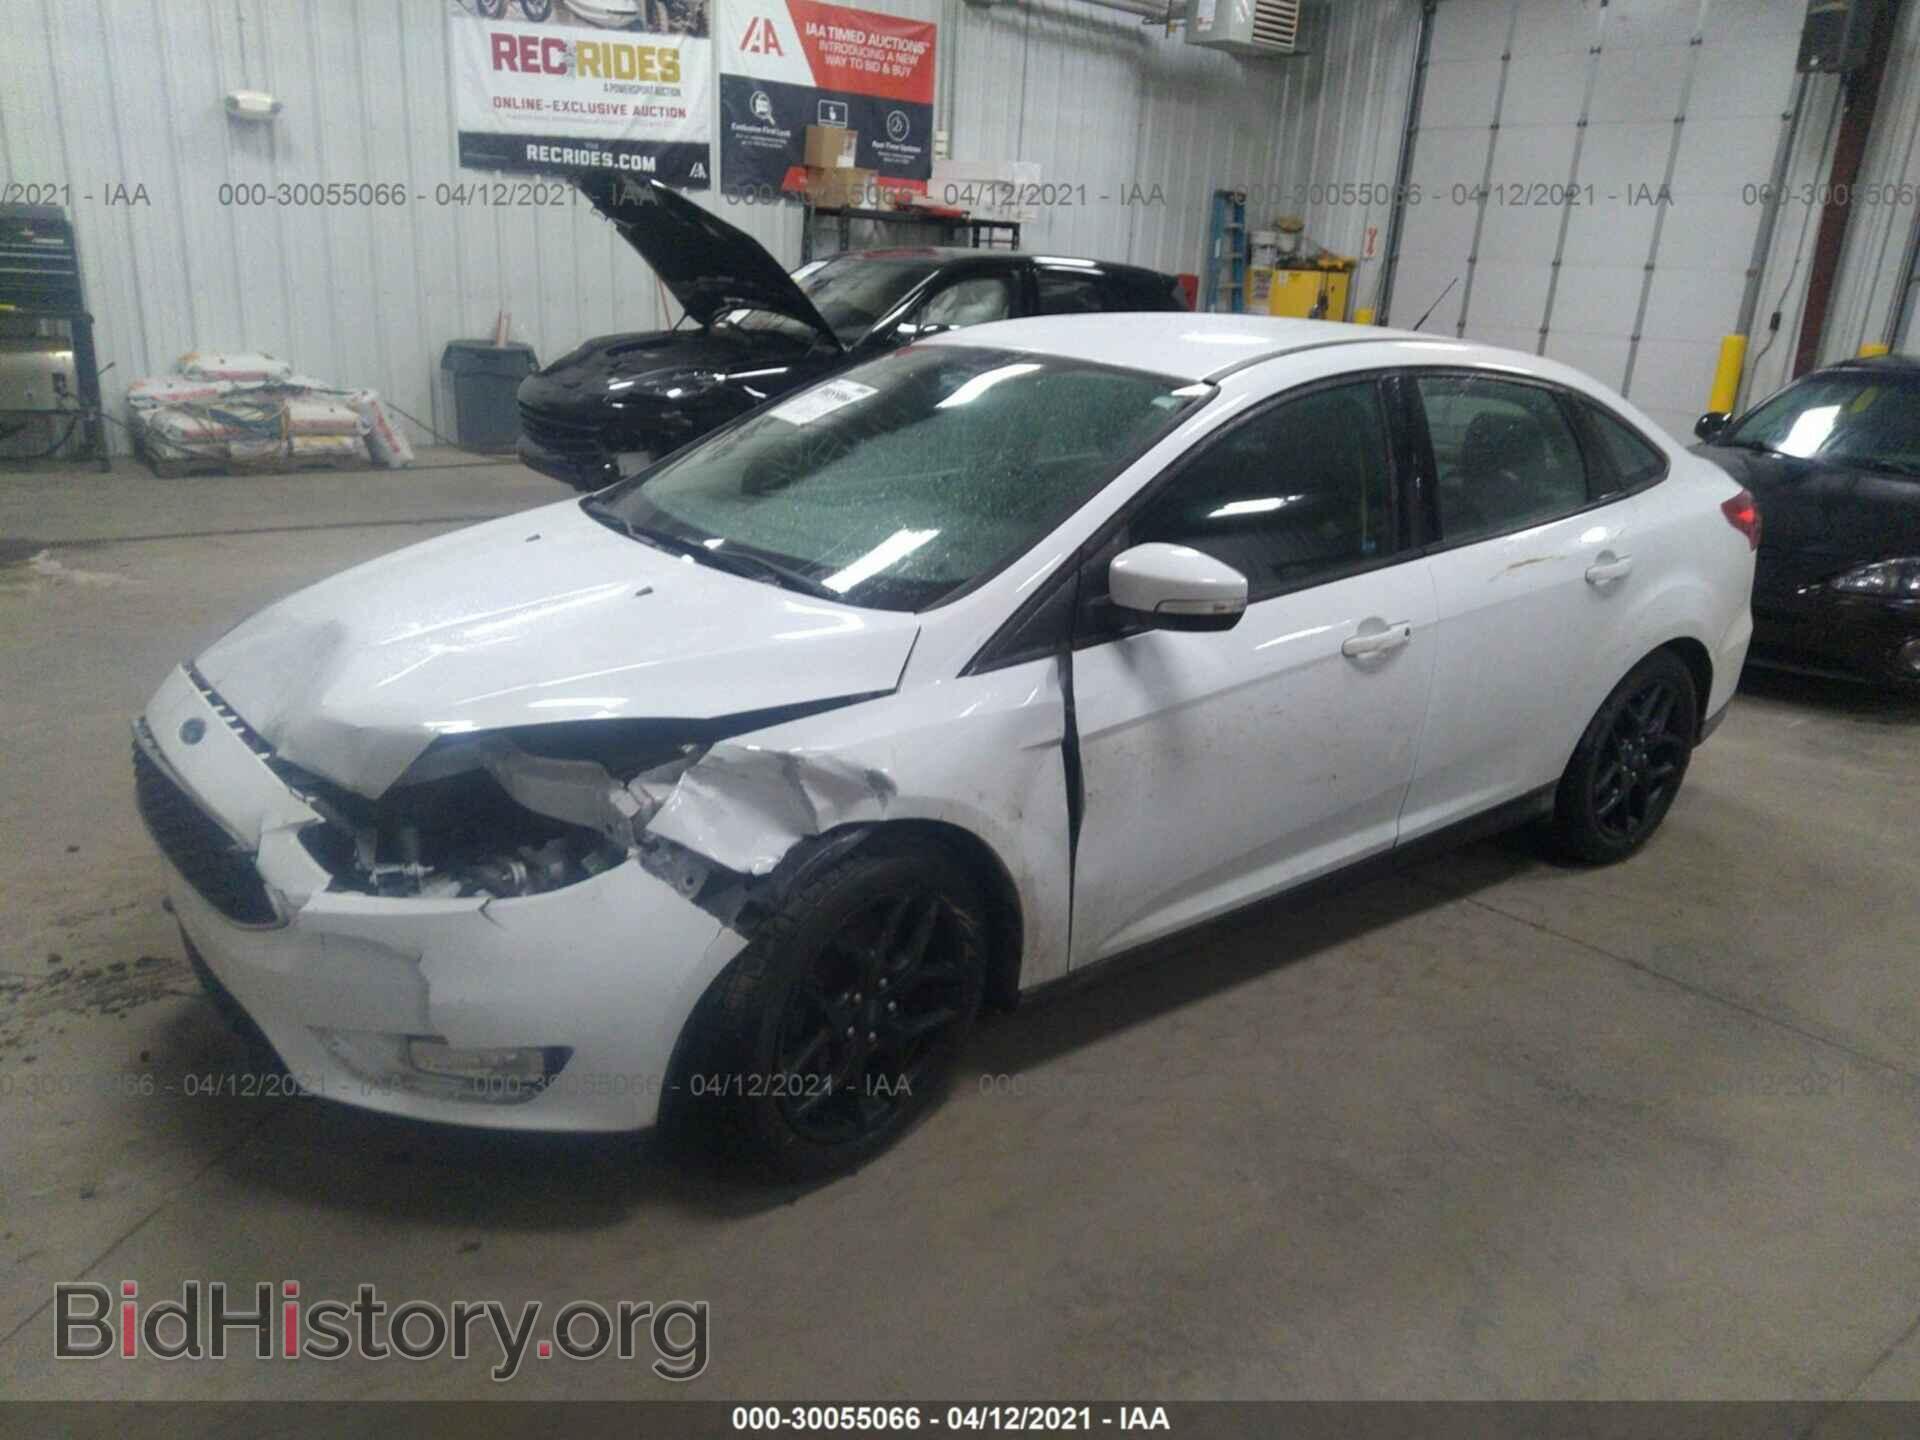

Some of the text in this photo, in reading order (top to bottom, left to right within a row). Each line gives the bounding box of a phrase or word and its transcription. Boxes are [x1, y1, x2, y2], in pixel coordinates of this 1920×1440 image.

[805, 22, 826, 38] IAA
[827, 26, 866, 45] TIMED
[490, 32, 682, 83] REC RIDES
[818, 40, 920, 65] INTRODUCING A NEW
[824, 54, 912, 77] WAY TO BID & BUY
[492, 96, 687, 119] ONLINE-EXCLUSIVE AUCTION
[526, 144, 656, 173] RECRIDES.COM
